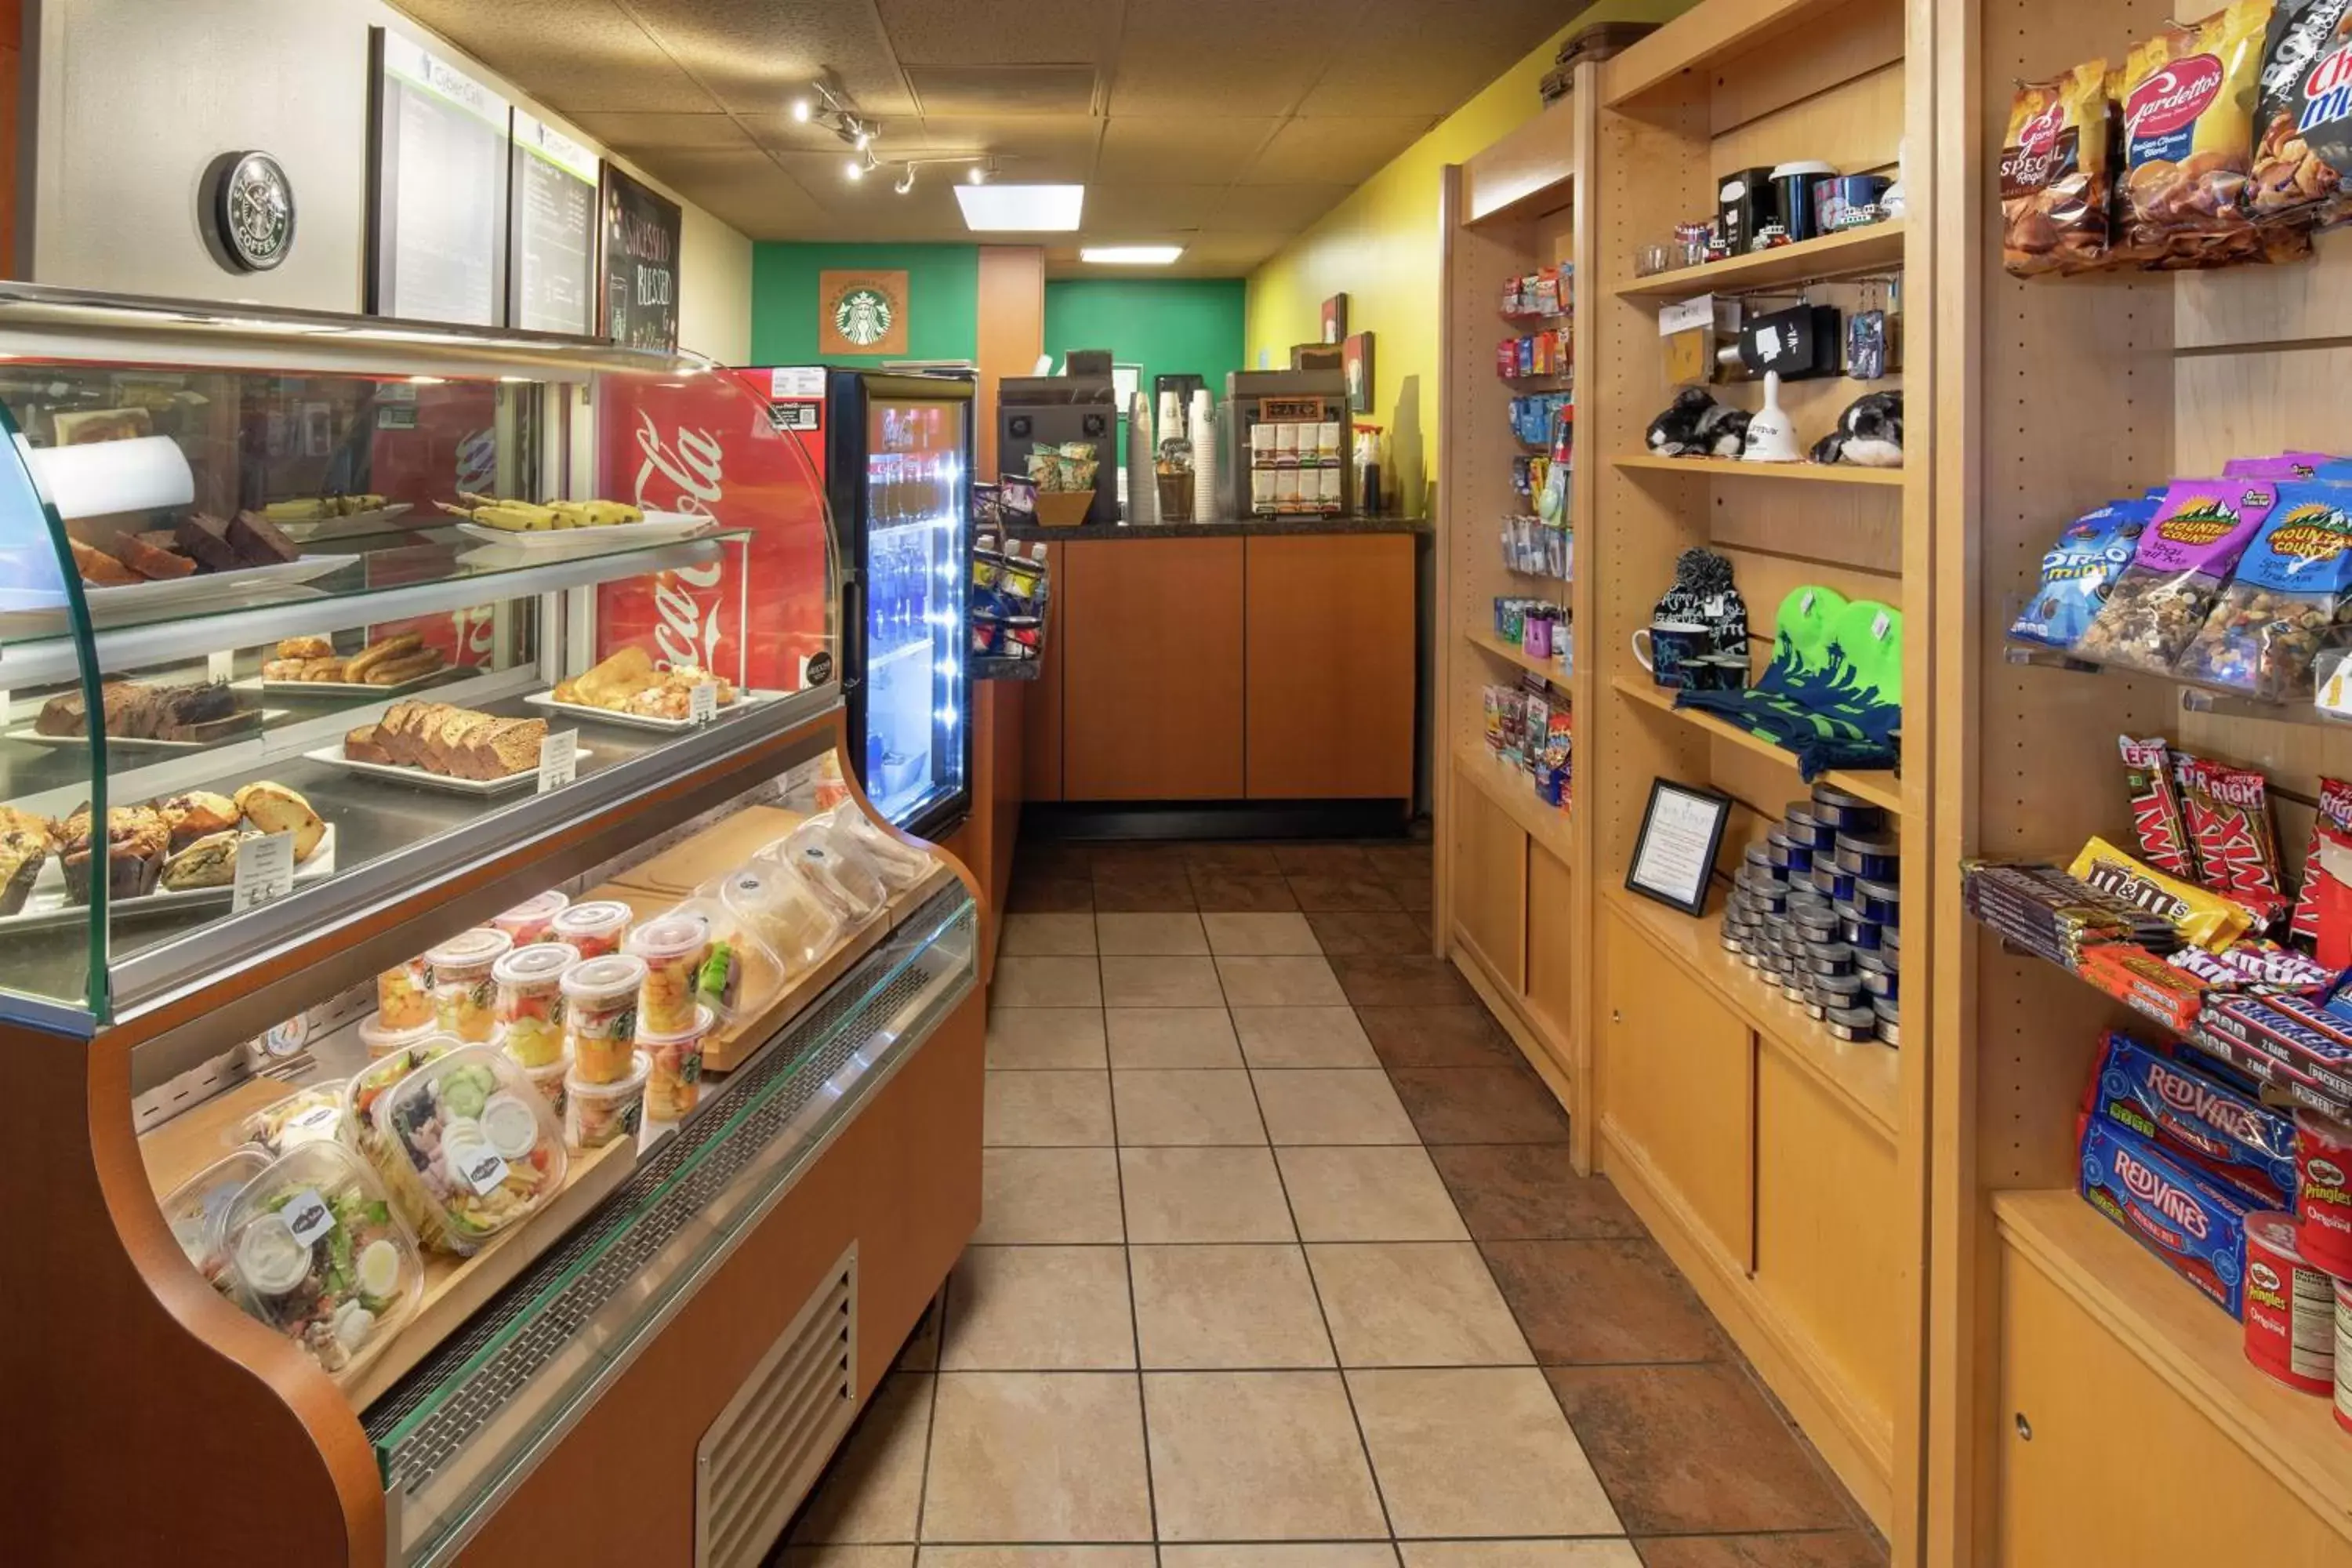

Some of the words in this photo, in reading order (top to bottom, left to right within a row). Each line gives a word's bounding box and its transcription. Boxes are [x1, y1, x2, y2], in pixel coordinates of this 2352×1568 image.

[239, 227, 277, 255] COFFEE
[637, 264, 673, 306] BLESSED
[2048, 561, 2108, 580] mini
[2152, 1174, 2209, 1240] VINES
[2305, 1182, 2351, 1206] Pringles
[2307, 1205, 2351, 1233] Original
[2249, 1284, 2286, 1311] Pringles
[2250, 1307, 2286, 1338] Original
